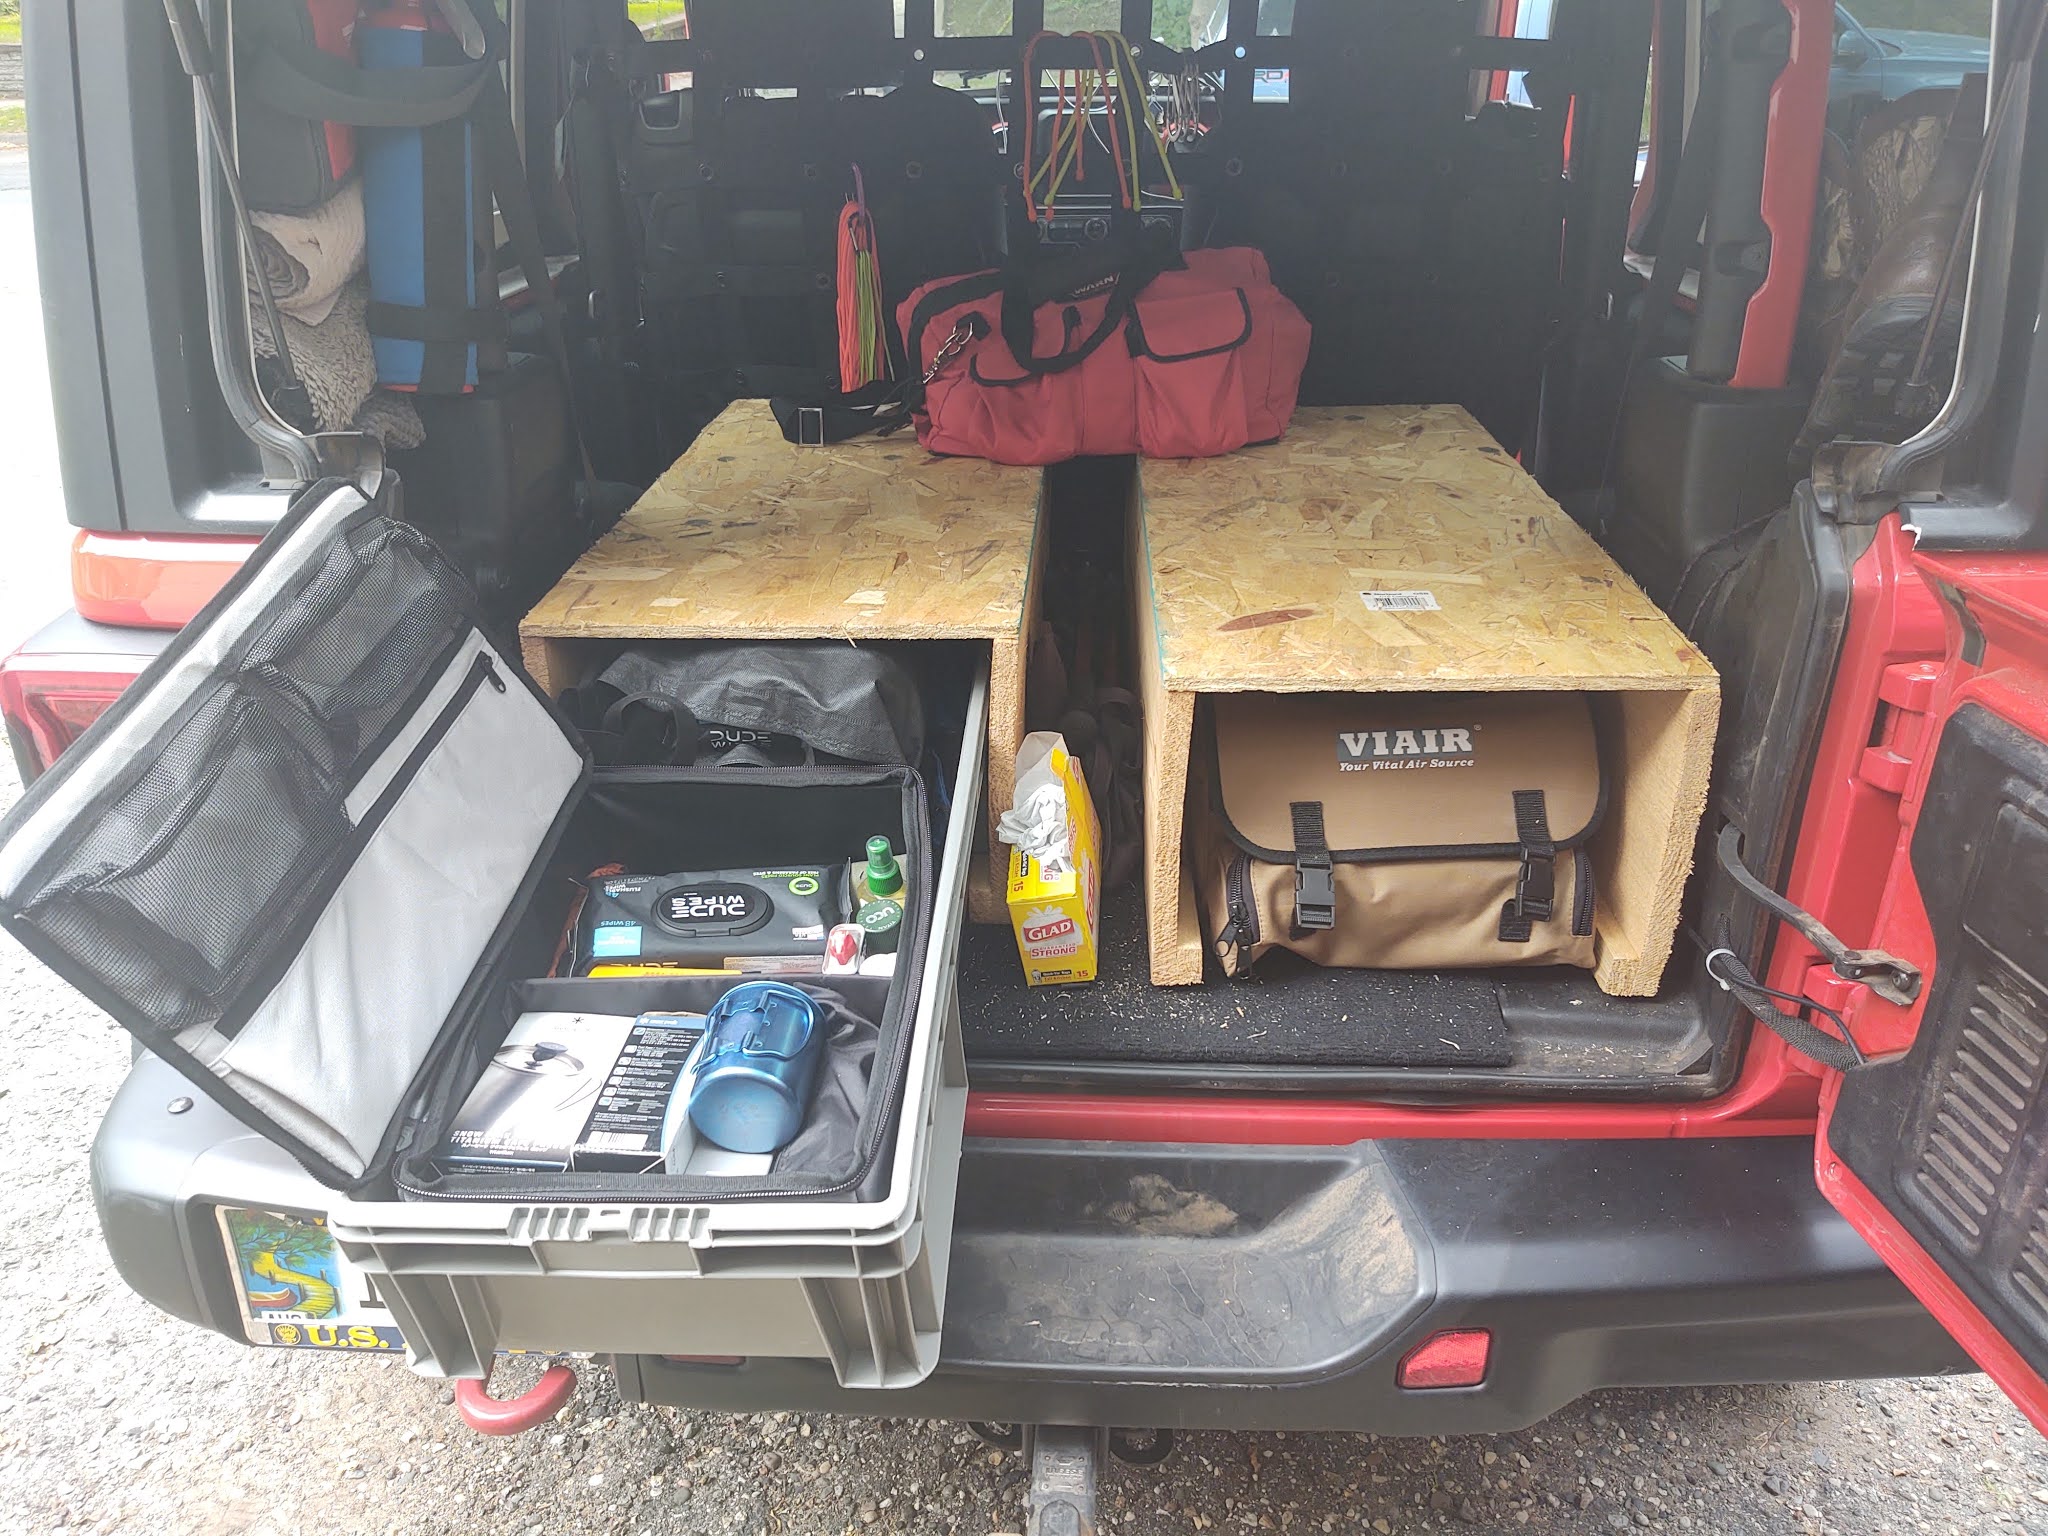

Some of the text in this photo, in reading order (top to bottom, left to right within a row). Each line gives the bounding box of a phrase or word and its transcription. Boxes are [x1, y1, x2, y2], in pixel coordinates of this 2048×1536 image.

[709, 730, 772, 743] DUDE
[1339, 728, 1473, 757] VIAIR
[1339, 759, 1475, 772] Your Vital Air Source
[1013, 881, 1024, 892] 15
[671, 895, 745, 906] WIPES
[671, 904, 746, 919] DUDE
[865, 906, 896, 924] UCO
[1028, 922, 1072, 941] GLAD
[1031, 946, 1076, 957] STRONG
[303, 1325, 389, 1348] U.S.
